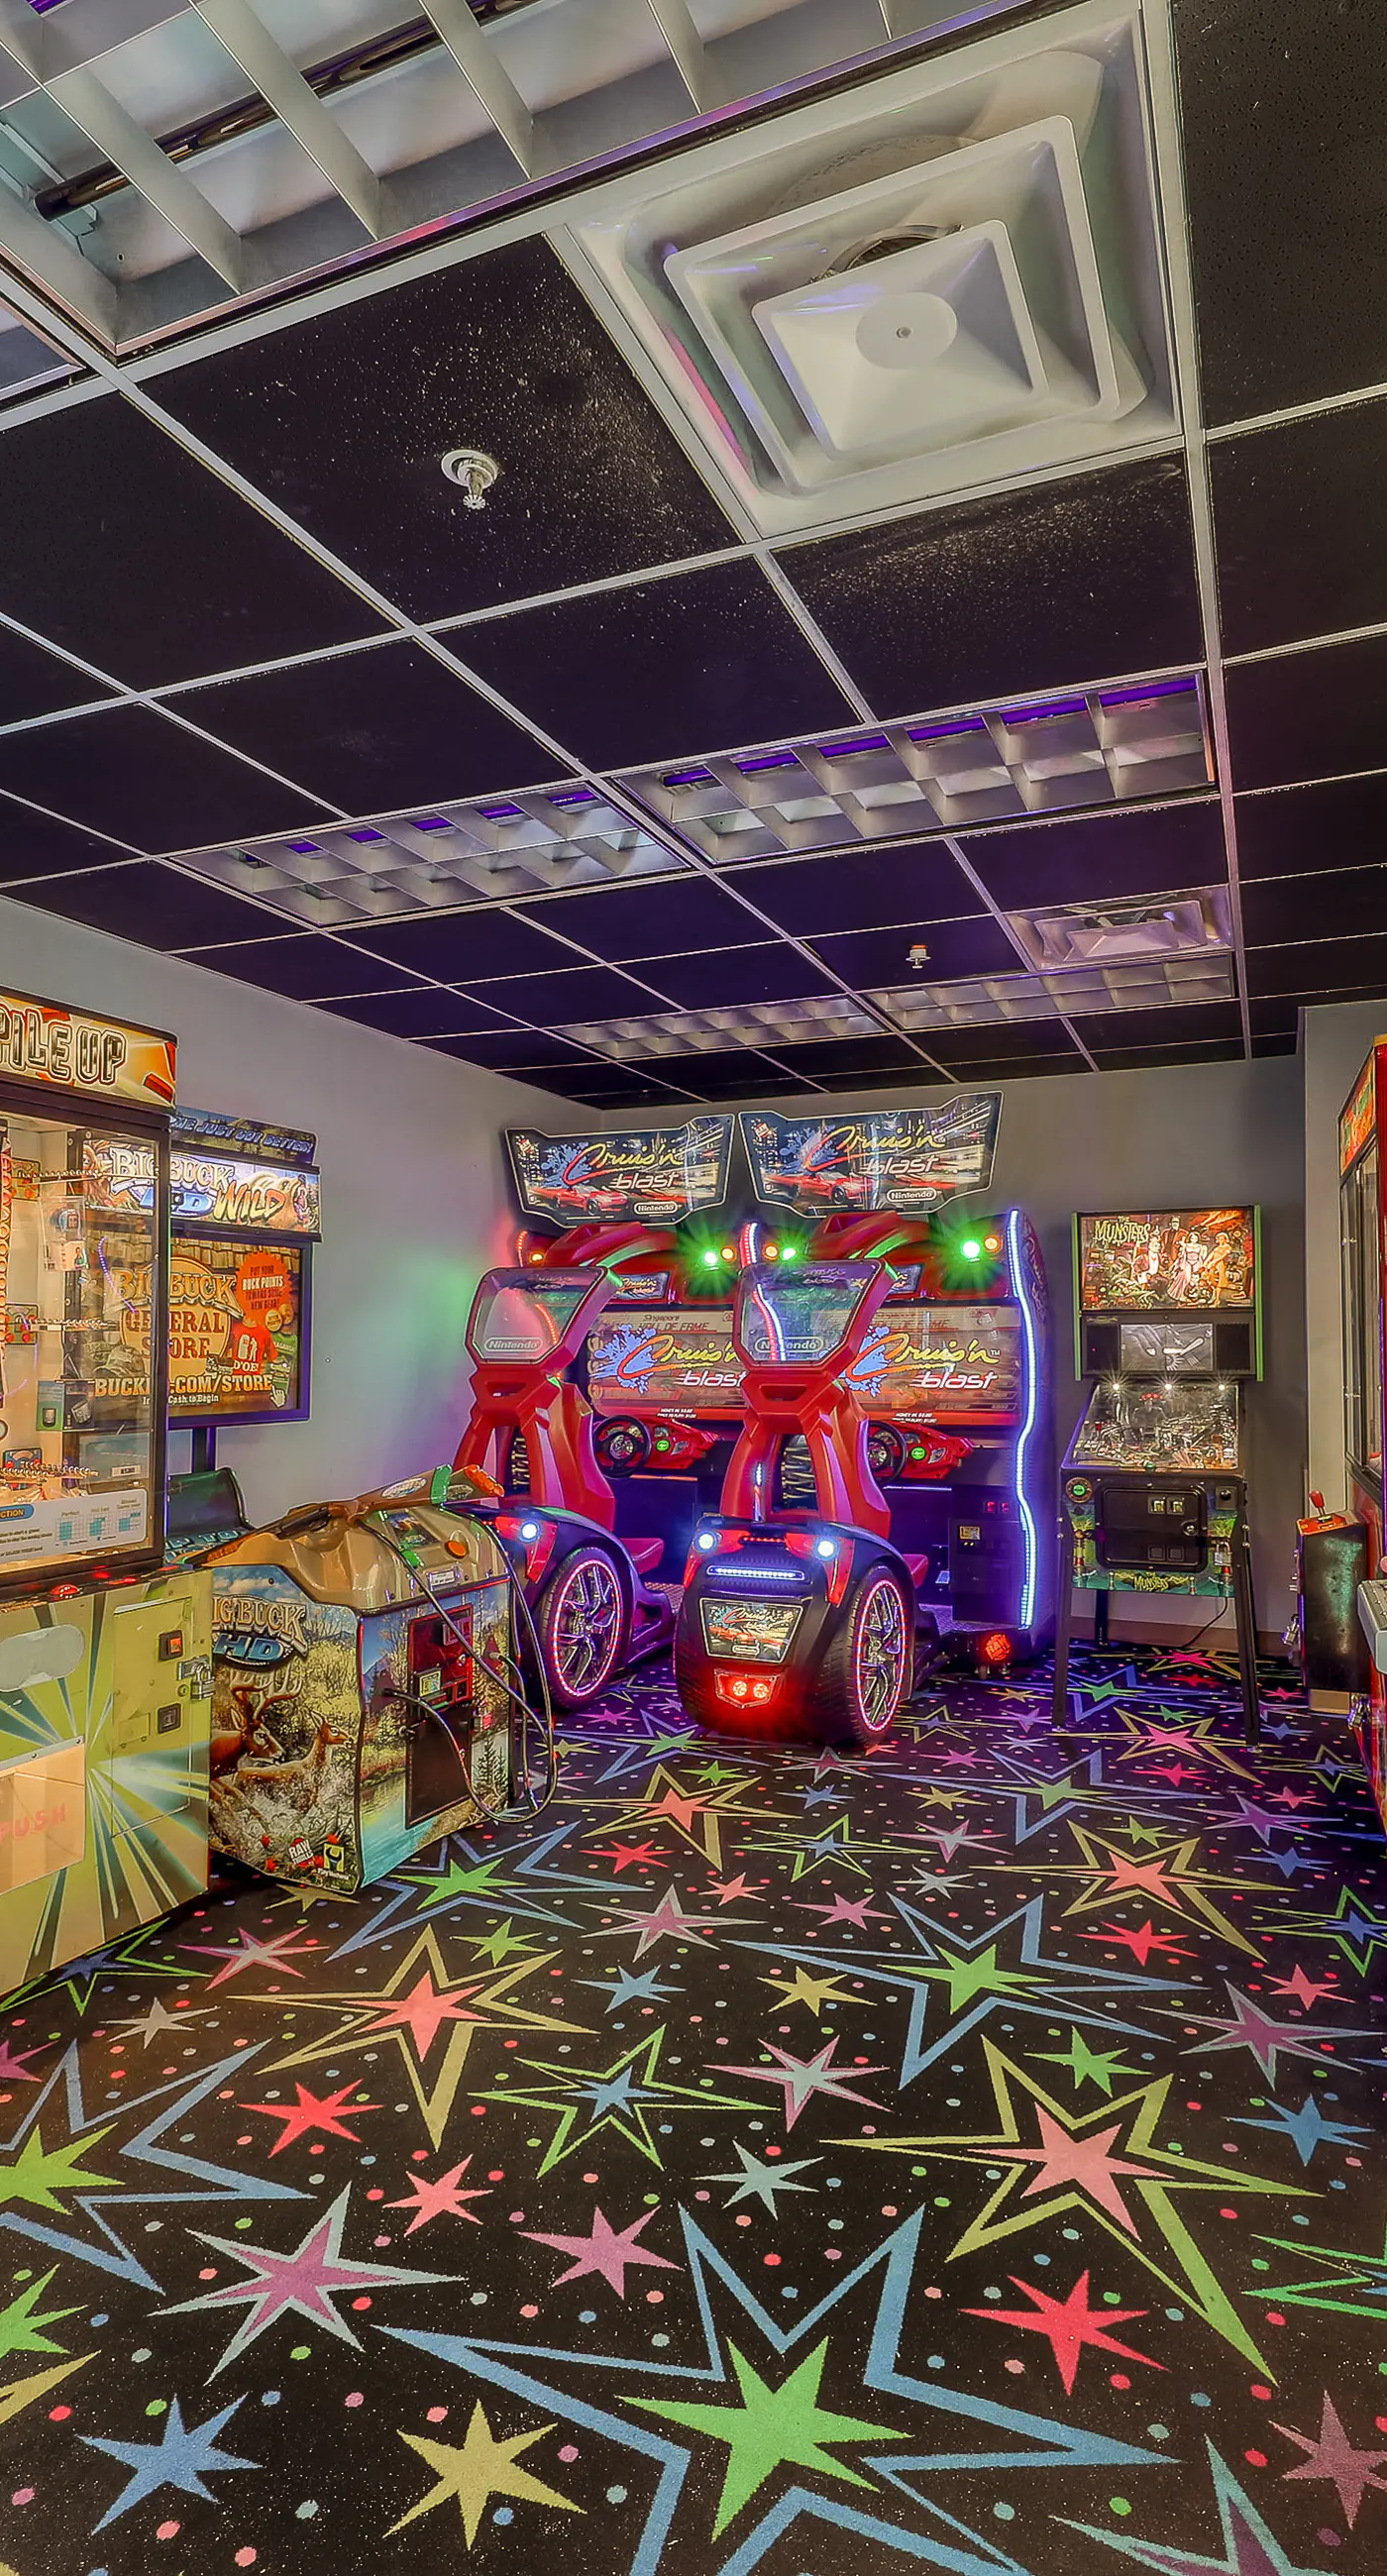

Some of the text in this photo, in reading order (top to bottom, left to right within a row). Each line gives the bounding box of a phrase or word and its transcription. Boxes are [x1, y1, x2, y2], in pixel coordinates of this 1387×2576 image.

[77, 1026, 126, 1085] UP
[196, 1120, 235, 1138] JUST
[235, 1127, 265, 1143] GOT
[805, 1126, 944, 1171] Cruis'n
[563, 1142, 684, 1186] Cruis'n
[865, 1156, 939, 1175] blast
[170, 1158, 235, 1193] BUCK
[612, 1172, 680, 1190] blast
[213, 1180, 286, 1221] WILD
[890, 1190, 933, 1201] Nintendo
[637, 1203, 675, 1213] Nintendo
[1093, 1220, 1150, 1245] MUNSTERS
[170, 1272, 240, 1307] BUCK
[243, 1275, 283, 1291] BUCK POINTS
[126, 1311, 224, 1333] GEERAL
[141, 1337, 210, 1358] SORE
[684, 1370, 747, 1386] blast
[918, 1371, 999, 1388] blast
[168, 1395, 188, 1405] Cash
[197, 1393, 219, 1404] Begin
[237, 1599, 308, 1651] BUCK
[213, 1632, 285, 1661] HD
[288, 1839, 312, 1860] RAW
